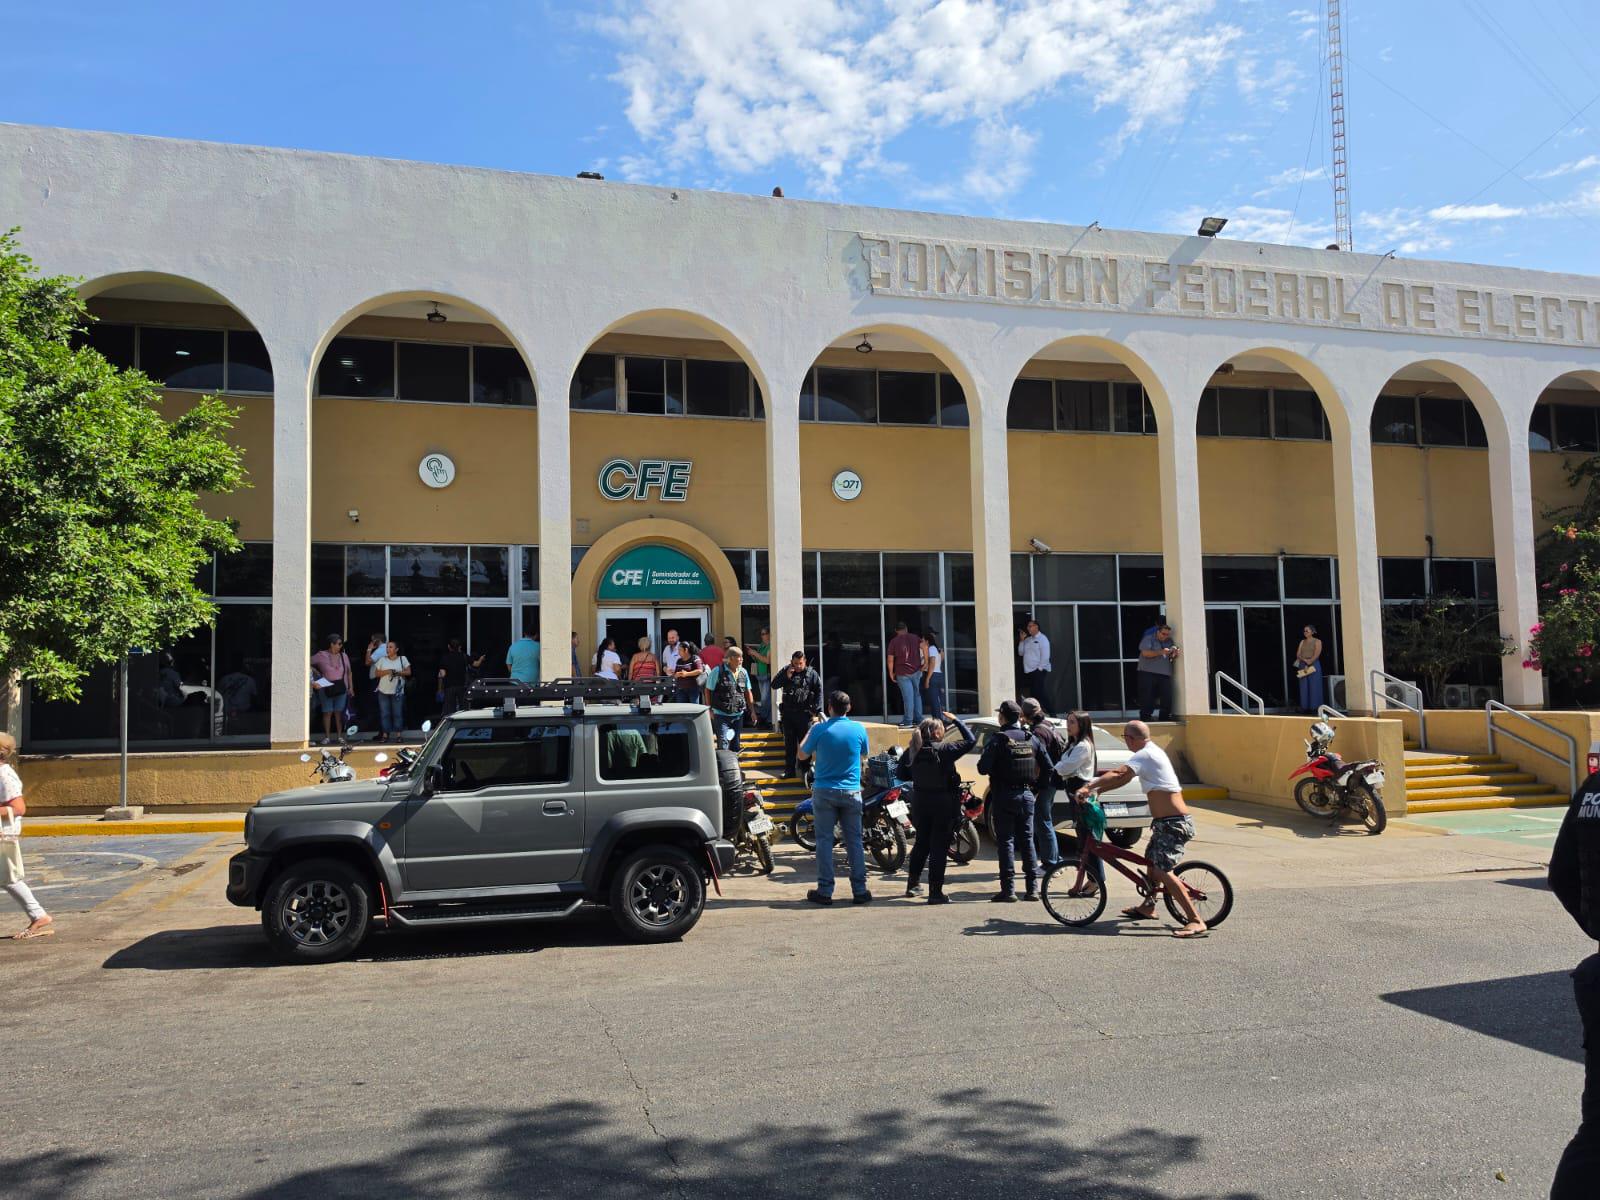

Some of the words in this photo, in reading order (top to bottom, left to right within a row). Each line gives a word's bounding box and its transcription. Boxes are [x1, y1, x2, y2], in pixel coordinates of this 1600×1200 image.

[862, 238, 1119, 304] COMISION
[1144, 261, 1362, 324] FEDERAL
[1381, 282, 1437, 329] DE
[1456, 289, 1600, 346] ELECT
[598, 459, 693, 501] CFE
[843, 480, 859, 489] 071
[612, 569, 643, 585] CFE
[651, 570, 691, 578] Suministrador
